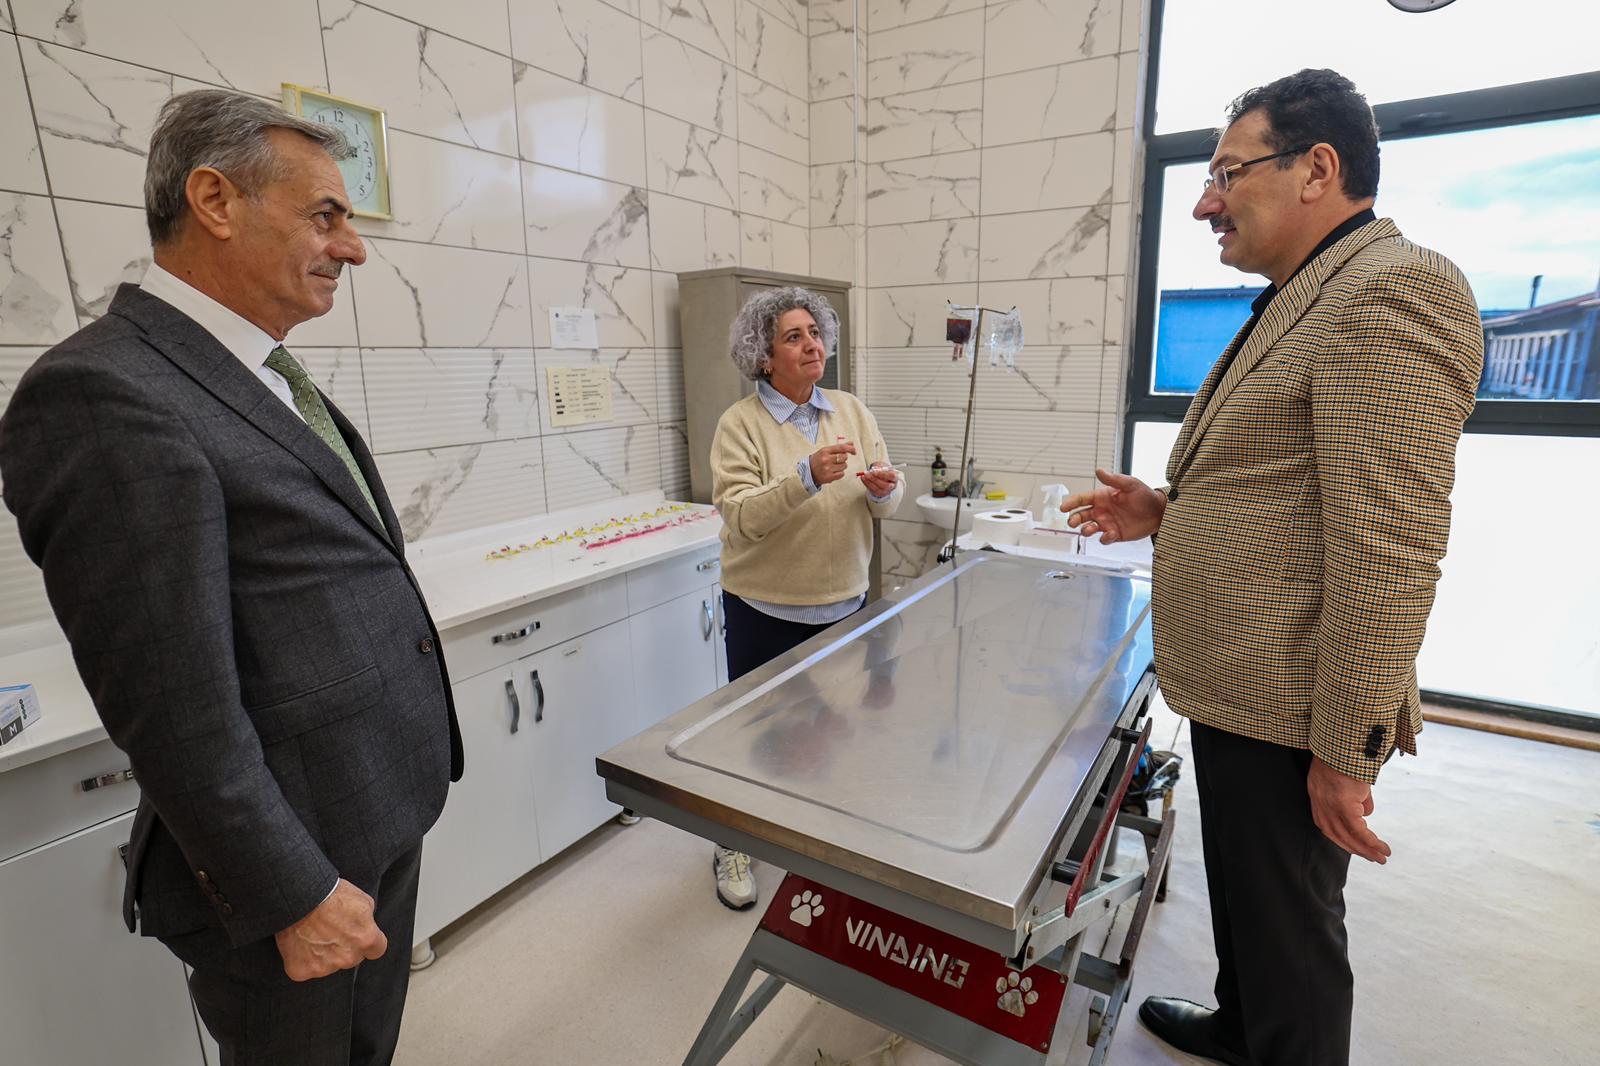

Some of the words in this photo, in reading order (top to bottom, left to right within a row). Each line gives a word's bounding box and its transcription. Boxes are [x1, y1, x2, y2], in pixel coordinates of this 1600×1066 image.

[333, 109, 344, 124] 12
[363, 140, 369, 153] 2
[367, 156, 373, 168] 3
[365, 171, 371, 182] 4
[359, 184, 365, 196] 5
[9, 722, 18, 737] M
